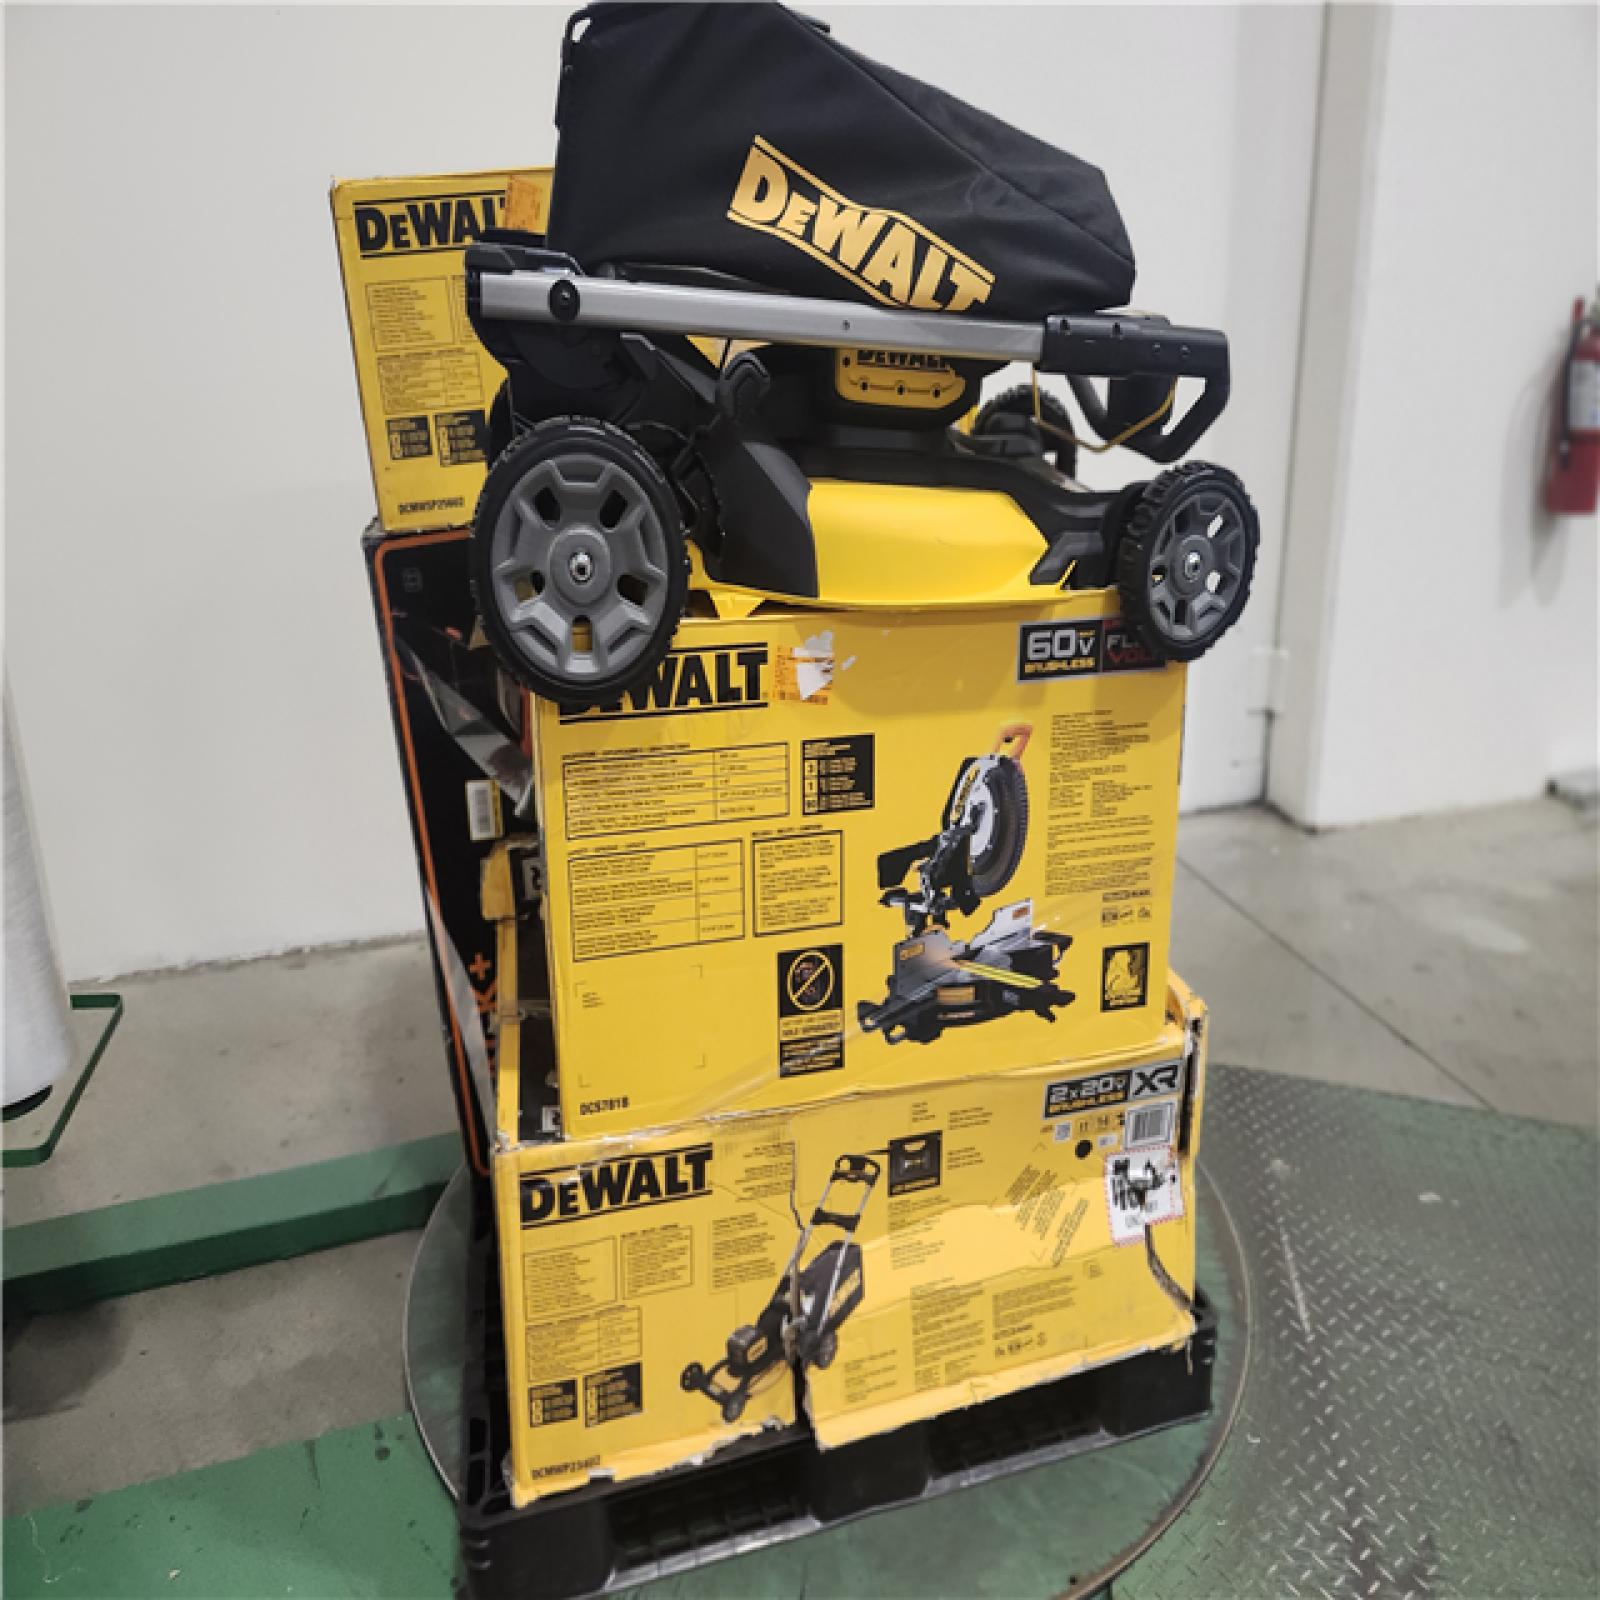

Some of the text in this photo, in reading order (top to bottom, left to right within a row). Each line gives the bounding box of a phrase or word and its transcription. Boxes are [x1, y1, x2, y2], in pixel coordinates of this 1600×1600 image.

[731, 148, 992, 312] DEWALT
[1134, 1065, 1178, 1096] XR
[520, 1151, 712, 1222] DEWALT
